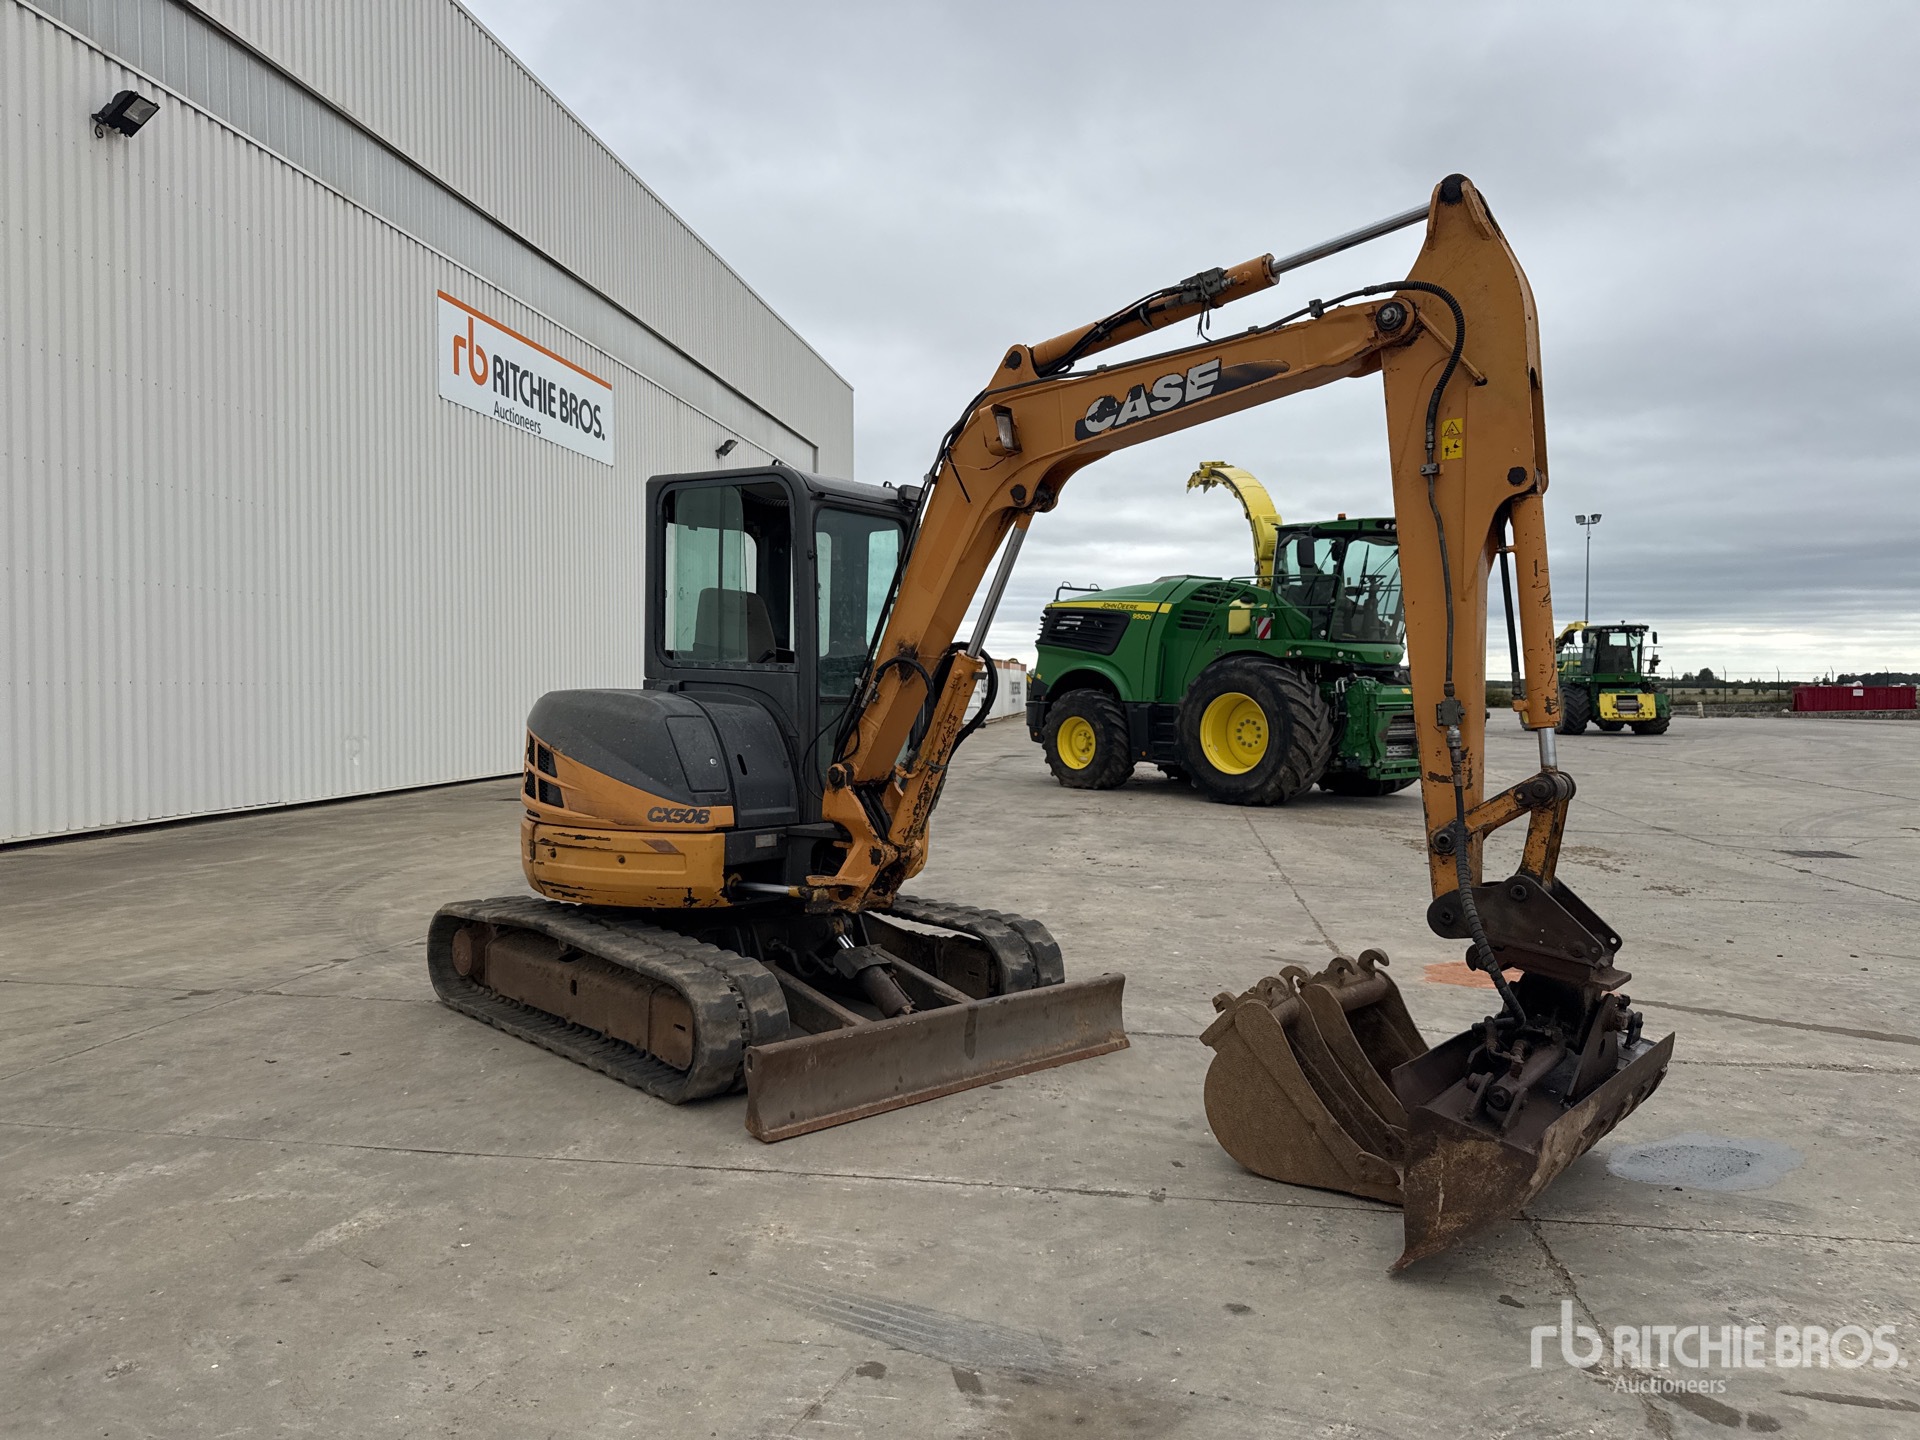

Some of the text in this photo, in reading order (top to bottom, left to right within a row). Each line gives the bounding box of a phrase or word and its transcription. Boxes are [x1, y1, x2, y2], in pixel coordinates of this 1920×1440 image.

[453, 315, 489, 386] rb
[492, 354, 606, 442] RITCHIE BROS.
[493, 400, 542, 435] Auctioneers
[1084, 358, 1221, 434] CASE
[647, 806, 711, 825] CX50B
